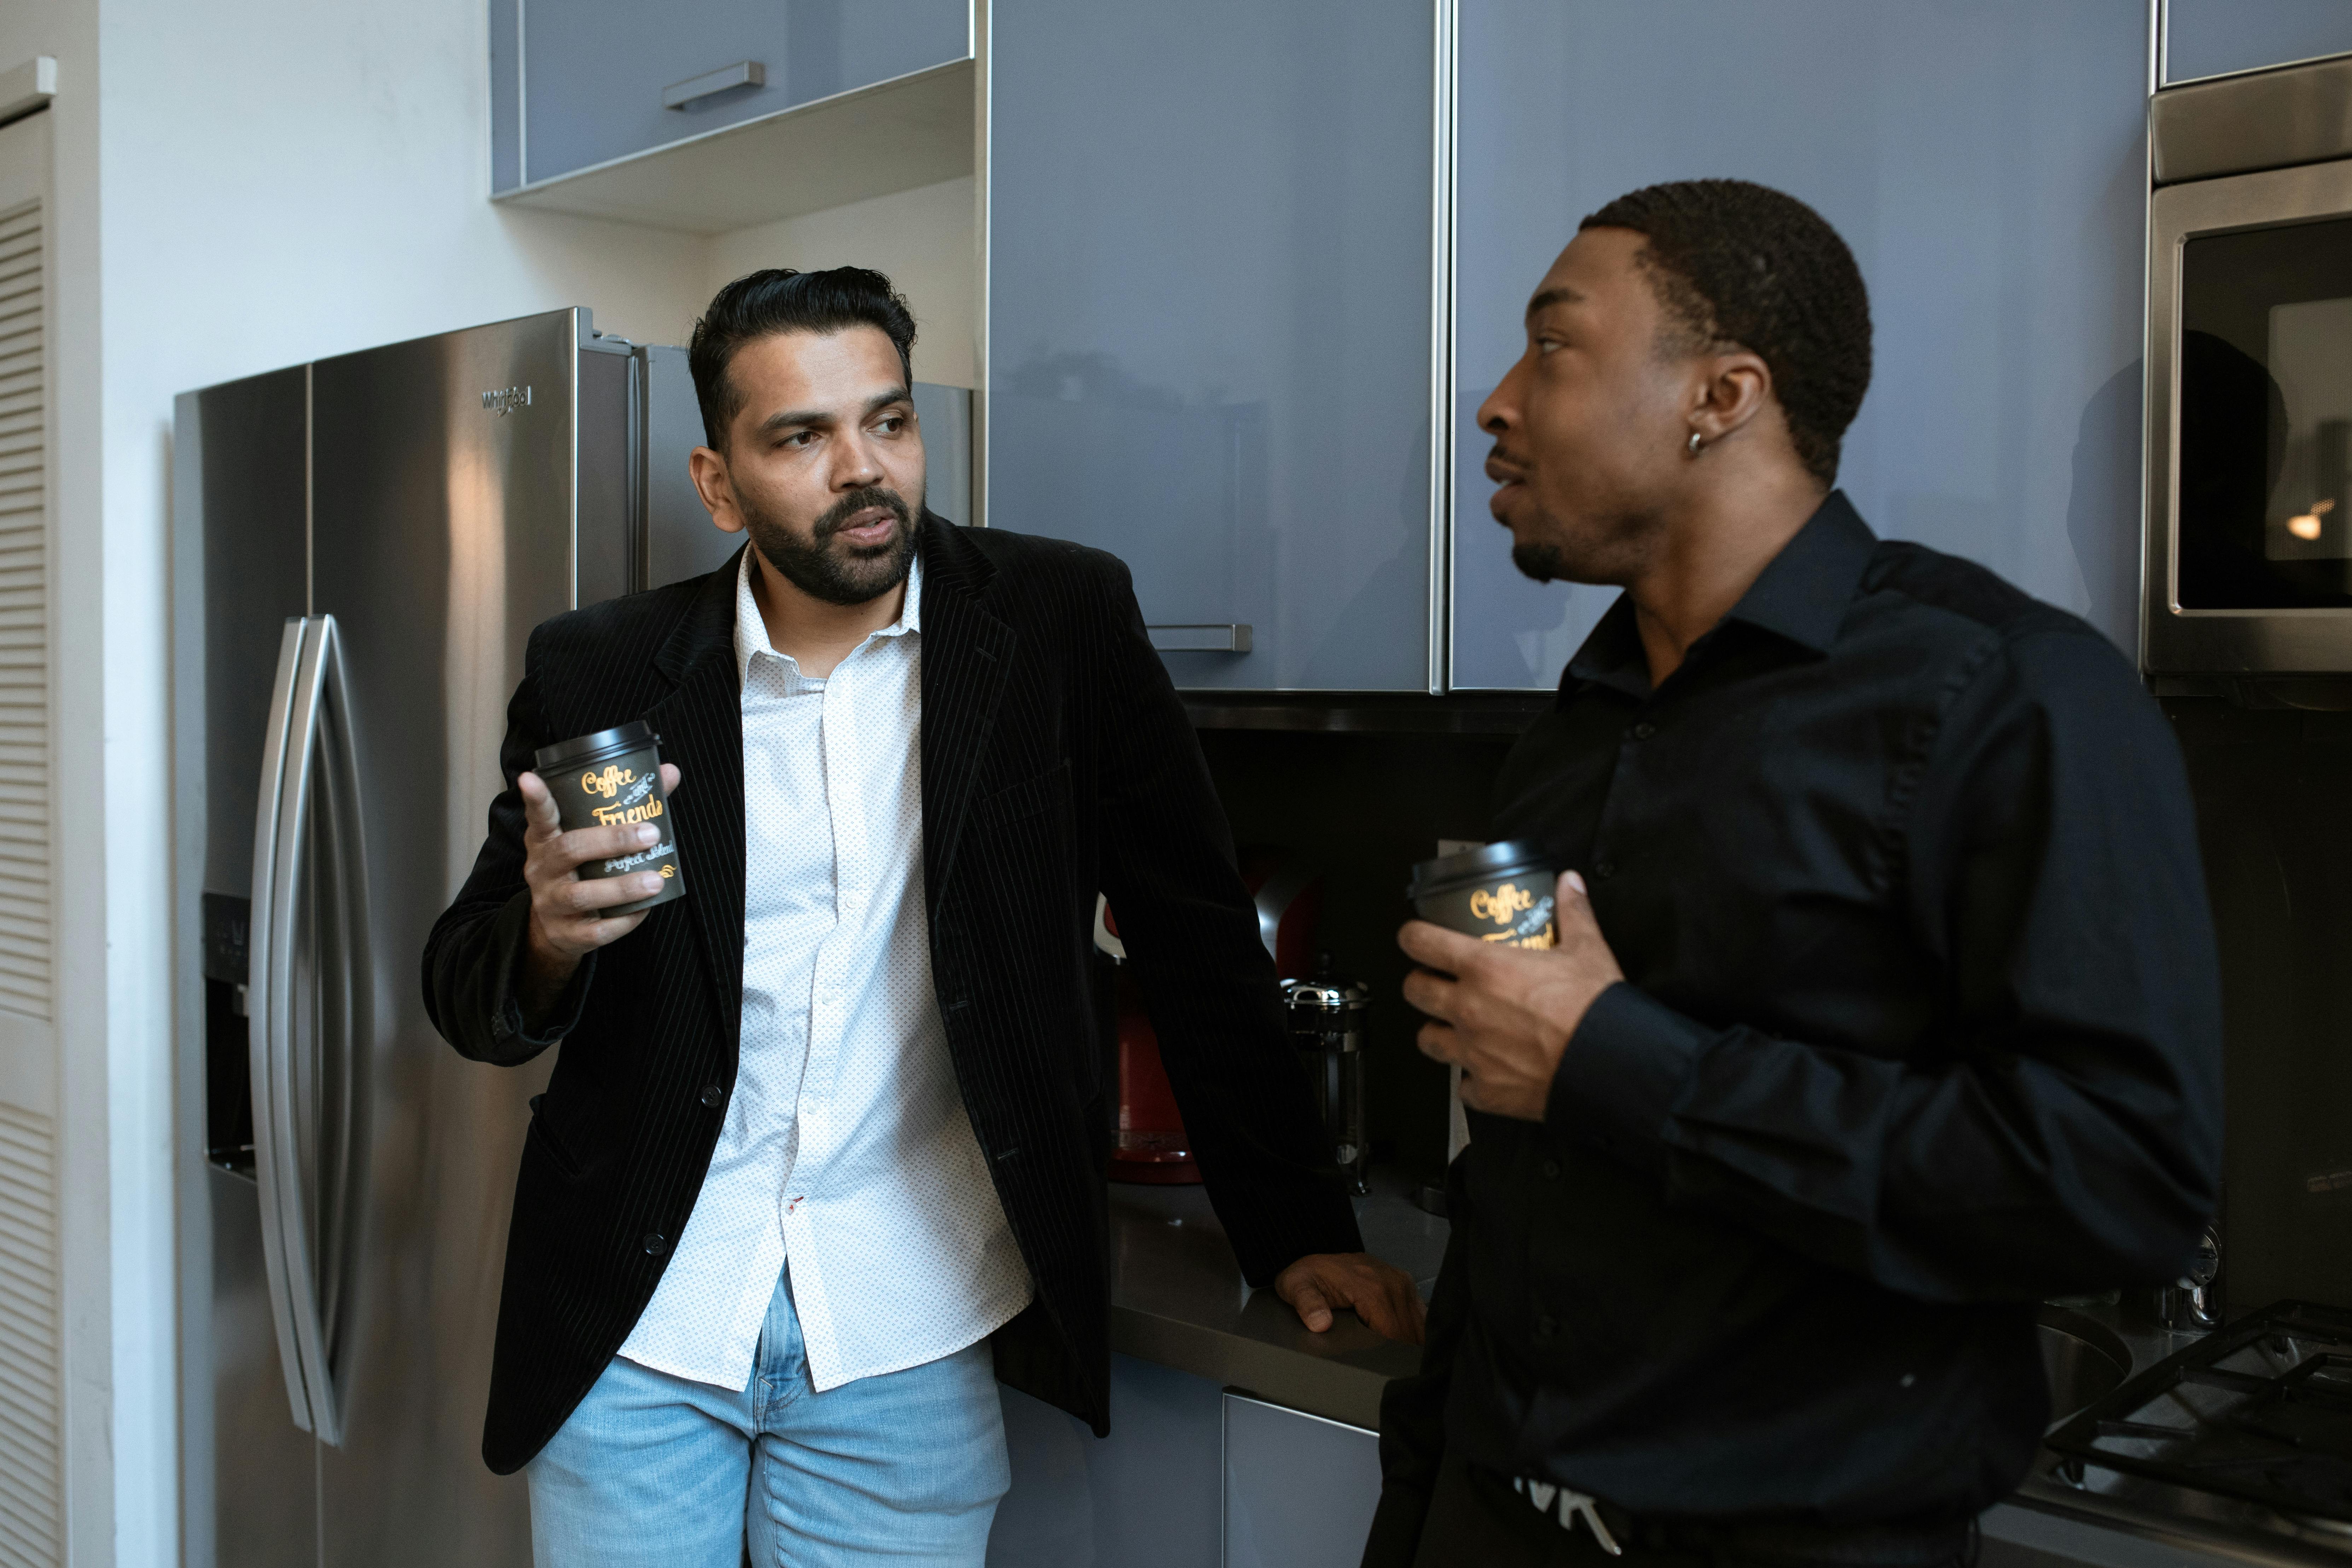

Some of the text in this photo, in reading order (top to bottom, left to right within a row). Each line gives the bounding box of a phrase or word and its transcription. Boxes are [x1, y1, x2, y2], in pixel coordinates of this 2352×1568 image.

[482, 385, 531, 417] Whirlpool
[581, 765, 637, 798] Coffee
[592, 794, 663, 826] Friends
[1470, 883, 1535, 925] Coffee
